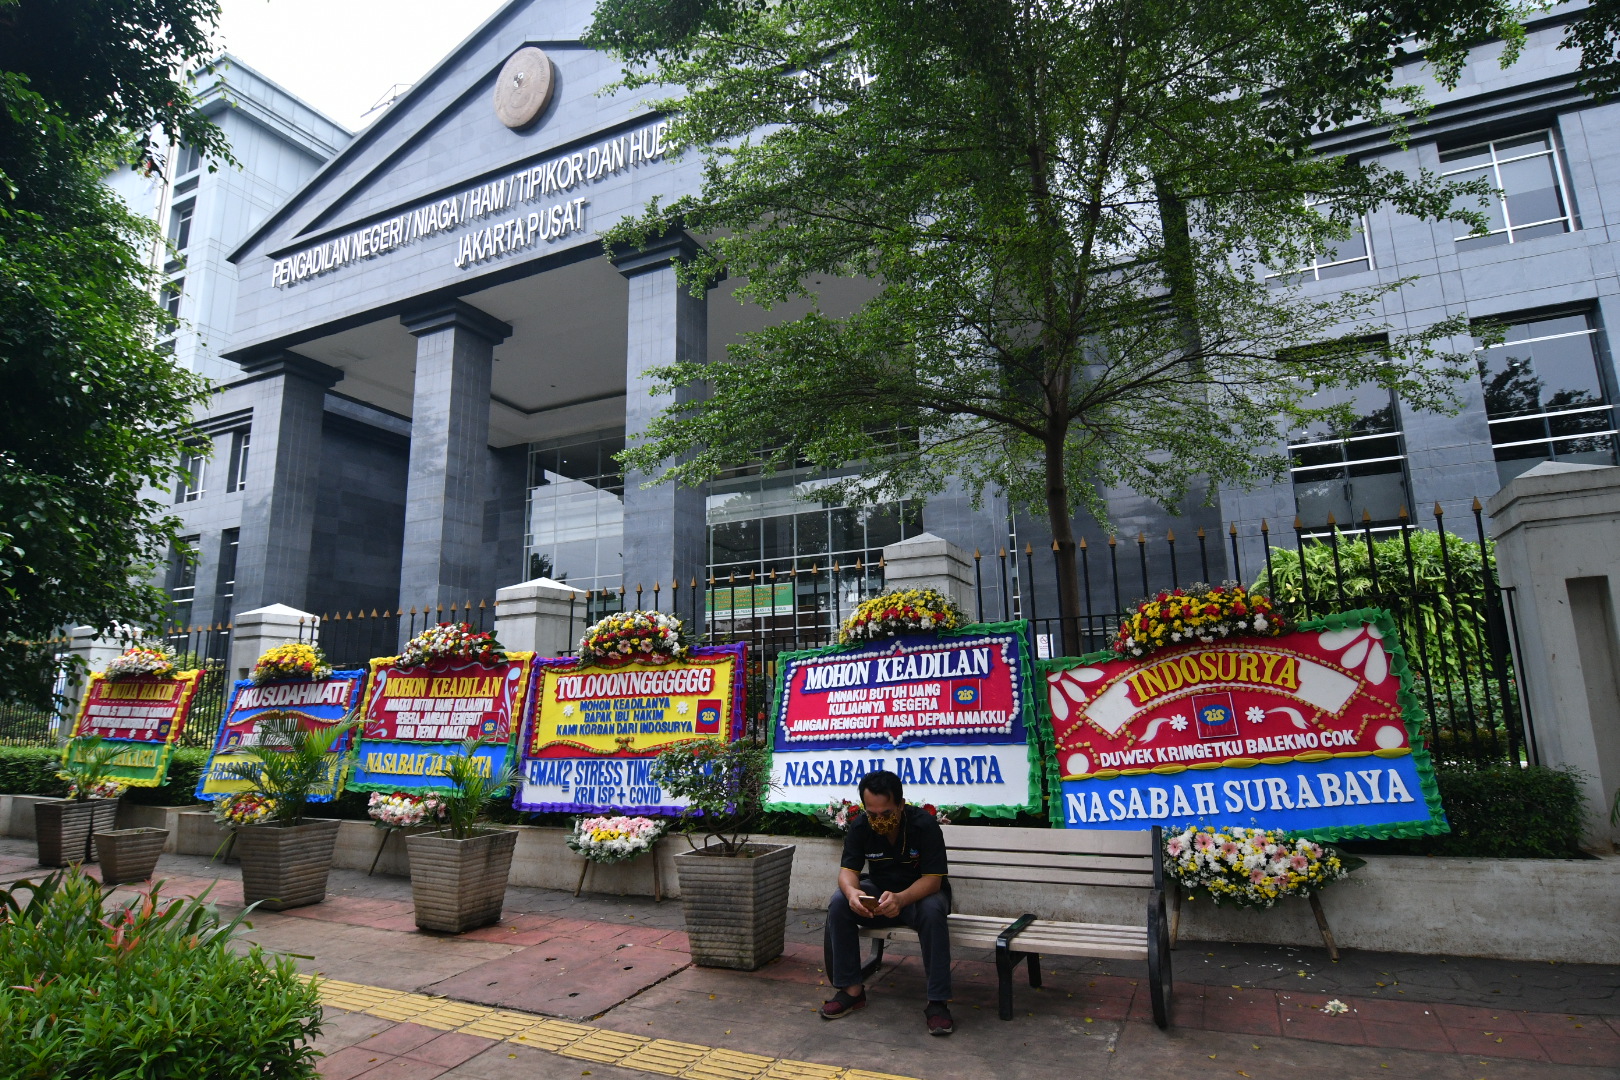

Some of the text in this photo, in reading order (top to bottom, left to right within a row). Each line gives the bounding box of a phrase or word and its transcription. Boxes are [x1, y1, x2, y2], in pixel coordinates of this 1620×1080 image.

[271, 235, 351, 288] PENGADILAN
[352, 214, 404, 259] NEGERI
[413, 196, 460, 237] NIAGA
[469, 180, 505, 218] HAM
[517, 152, 584, 204] TIPIKOR
[586, 139, 625, 180] DAN
[454, 196, 587, 268] JAKARTA PUSAT
[804, 648, 990, 691] MOHON KEADILAN
[1127, 652, 1299, 703] INDOSURYA
[383, 676, 504, 697] MOHON KEADILAN
[557, 668, 712, 699] TOLOOONNGGGGGG
[827, 683, 941, 704] ANNAKU BUTUH UANG
[580, 697, 670, 711] MOHON KEADILANYA
[584, 709, 664, 722] BAPAK IBU HAKIM
[828, 698, 938, 716] KULIAHNYA SEGERA
[556, 721, 693, 735] KAMI KORBAN DARI INDOSURYA
[790, 710, 1006, 732] JANGAN RENGGUT MASA DEPAN ANAKKU
[1100, 728, 1358, 768] DUWEK KRINGETKU BALEKNO COK
[366, 752, 427, 776] NASABAH
[574, 760, 623, 786] STRESS
[783, 755, 1005, 787] NASABAH JAKARTA
[574, 786, 595, 804] KRN
[598, 786, 615, 803] ISP
[629, 786, 661, 804] COVID
[1065, 768, 1414, 825] NASABAH SURABAYA
